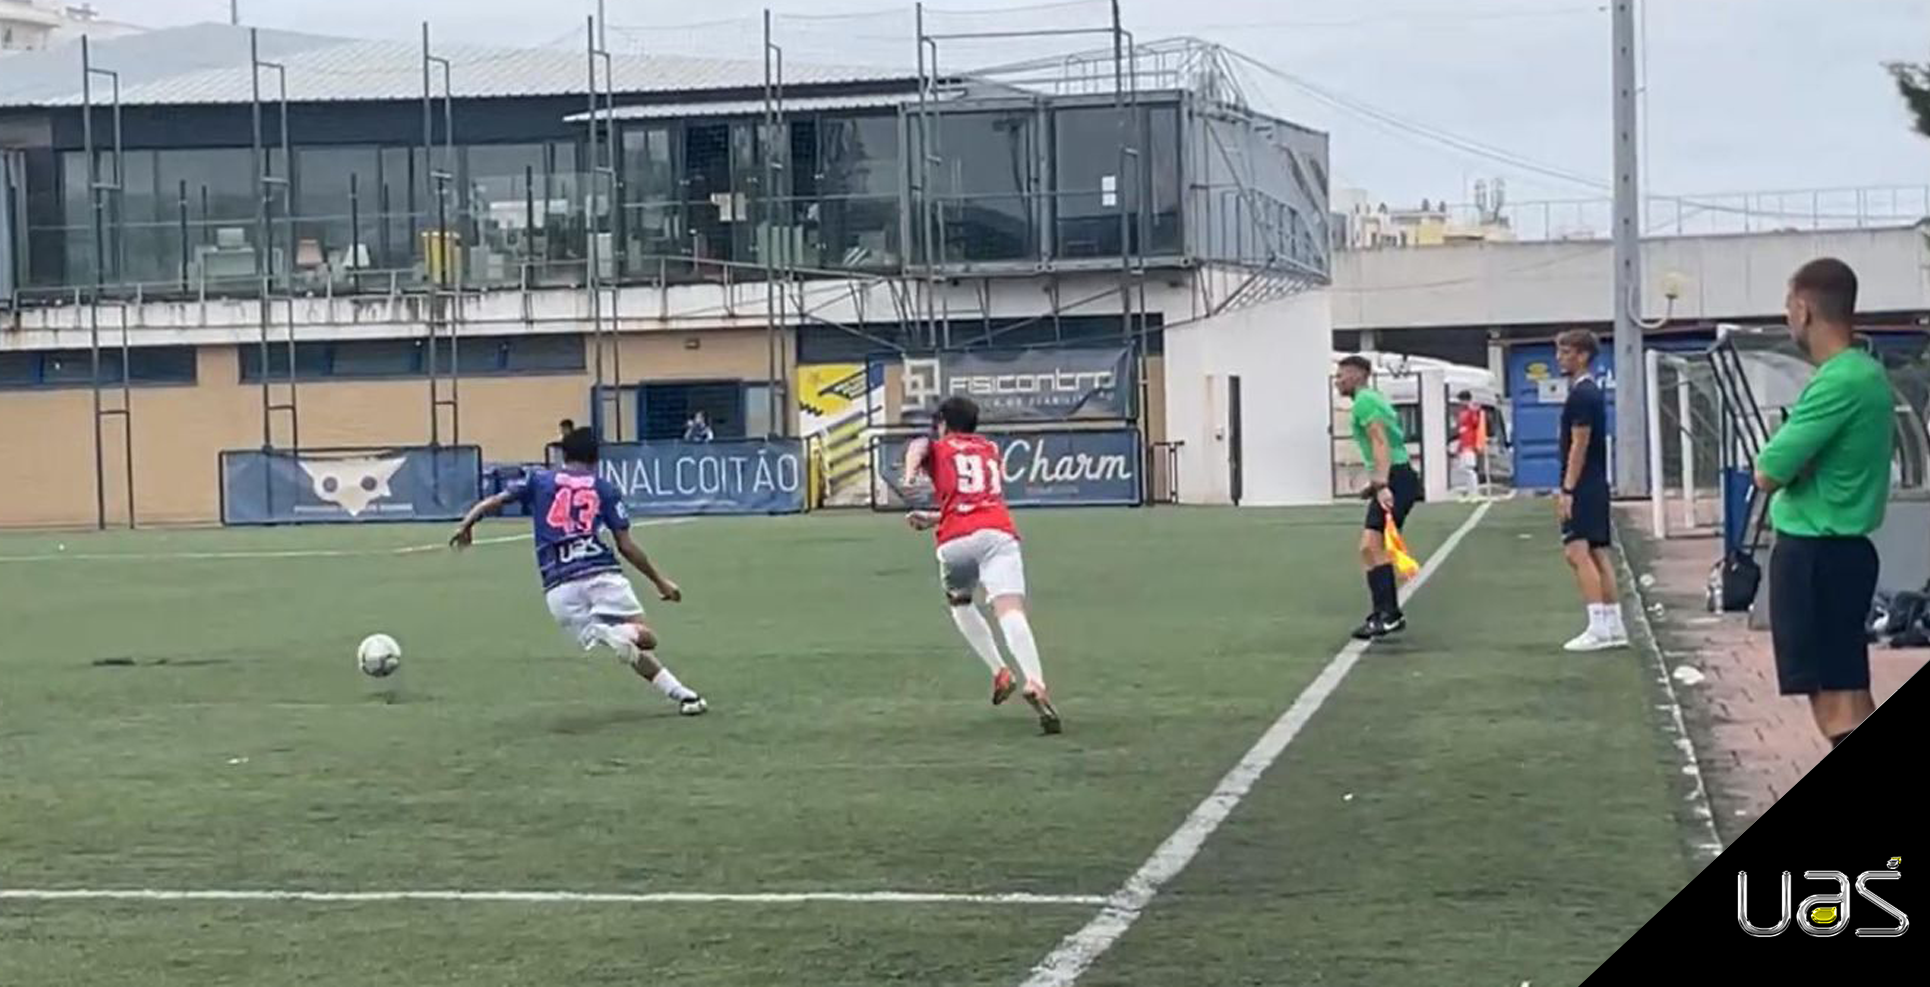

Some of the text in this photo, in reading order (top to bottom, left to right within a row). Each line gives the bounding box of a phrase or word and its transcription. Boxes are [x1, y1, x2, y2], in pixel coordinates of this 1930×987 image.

[954, 453, 1001, 495] 91
[1002, 439, 1132, 482] Charm
[546, 487, 600, 534] 43
